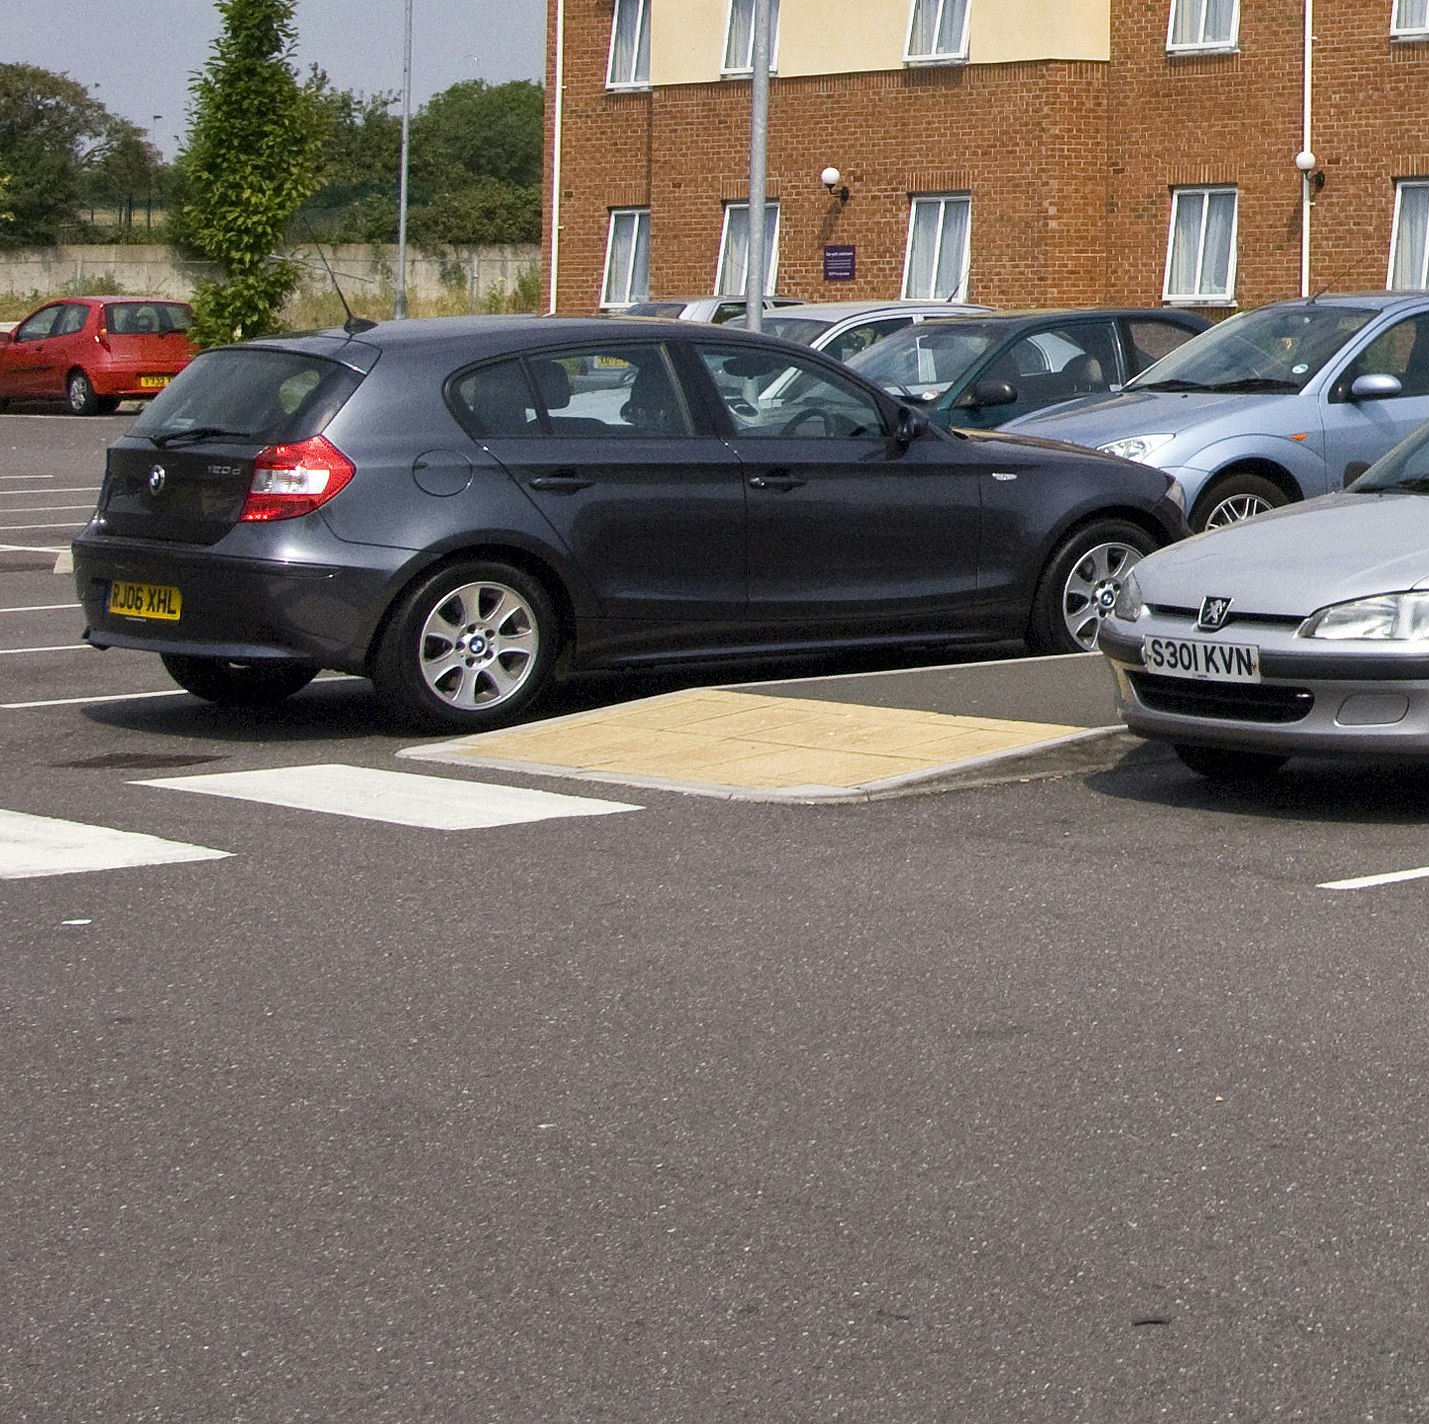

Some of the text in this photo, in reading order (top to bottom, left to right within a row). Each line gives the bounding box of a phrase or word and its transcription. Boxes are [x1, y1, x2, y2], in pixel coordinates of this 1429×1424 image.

[111, 583, 177, 614] RJ06 XHL
[1151, 639, 1253, 676] S301 KVN
